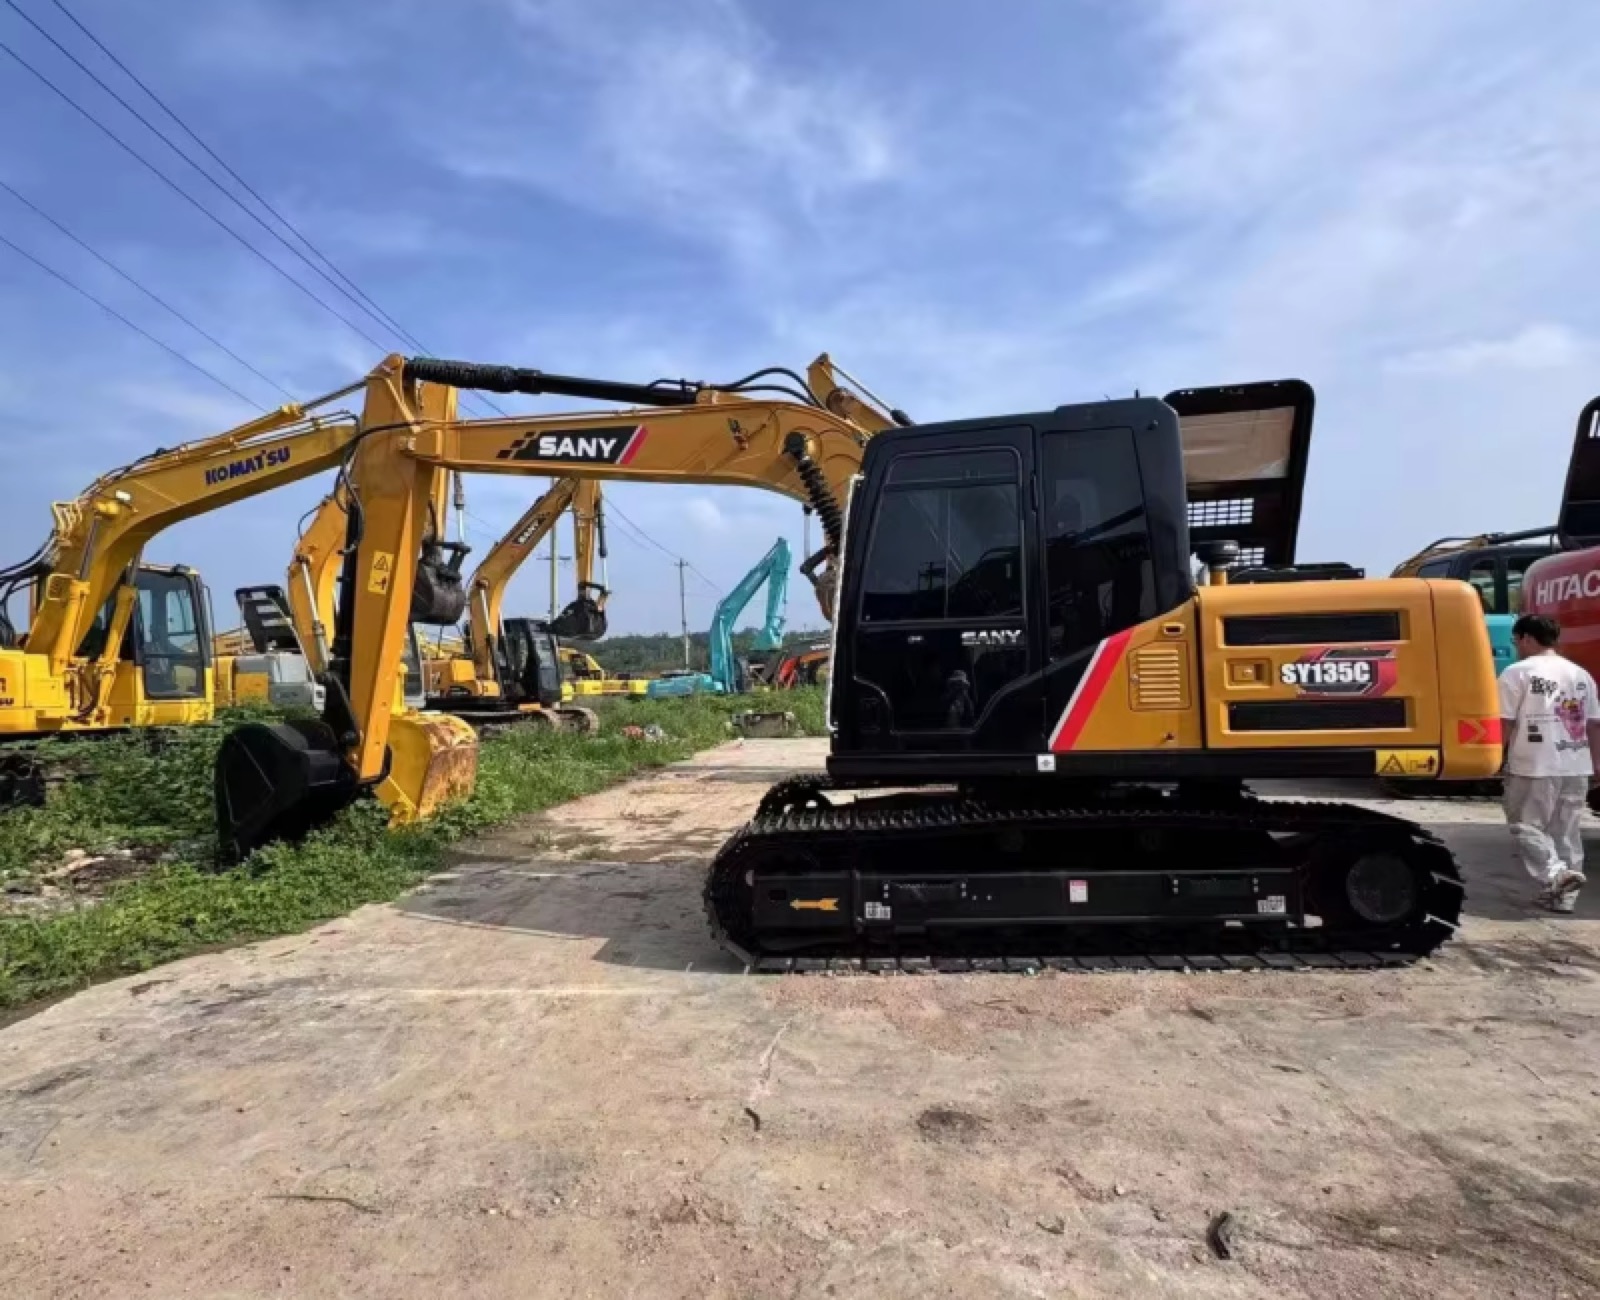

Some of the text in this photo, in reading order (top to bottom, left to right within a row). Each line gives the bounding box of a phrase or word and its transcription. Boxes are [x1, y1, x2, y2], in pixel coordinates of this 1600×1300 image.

[538, 435, 616, 459] SANY
[205, 446, 290, 486] KOMATSU
[1535, 570, 1600, 607] HITAC
[961, 629, 1022, 646] SANY
[1281, 661, 1371, 684] SY135C
